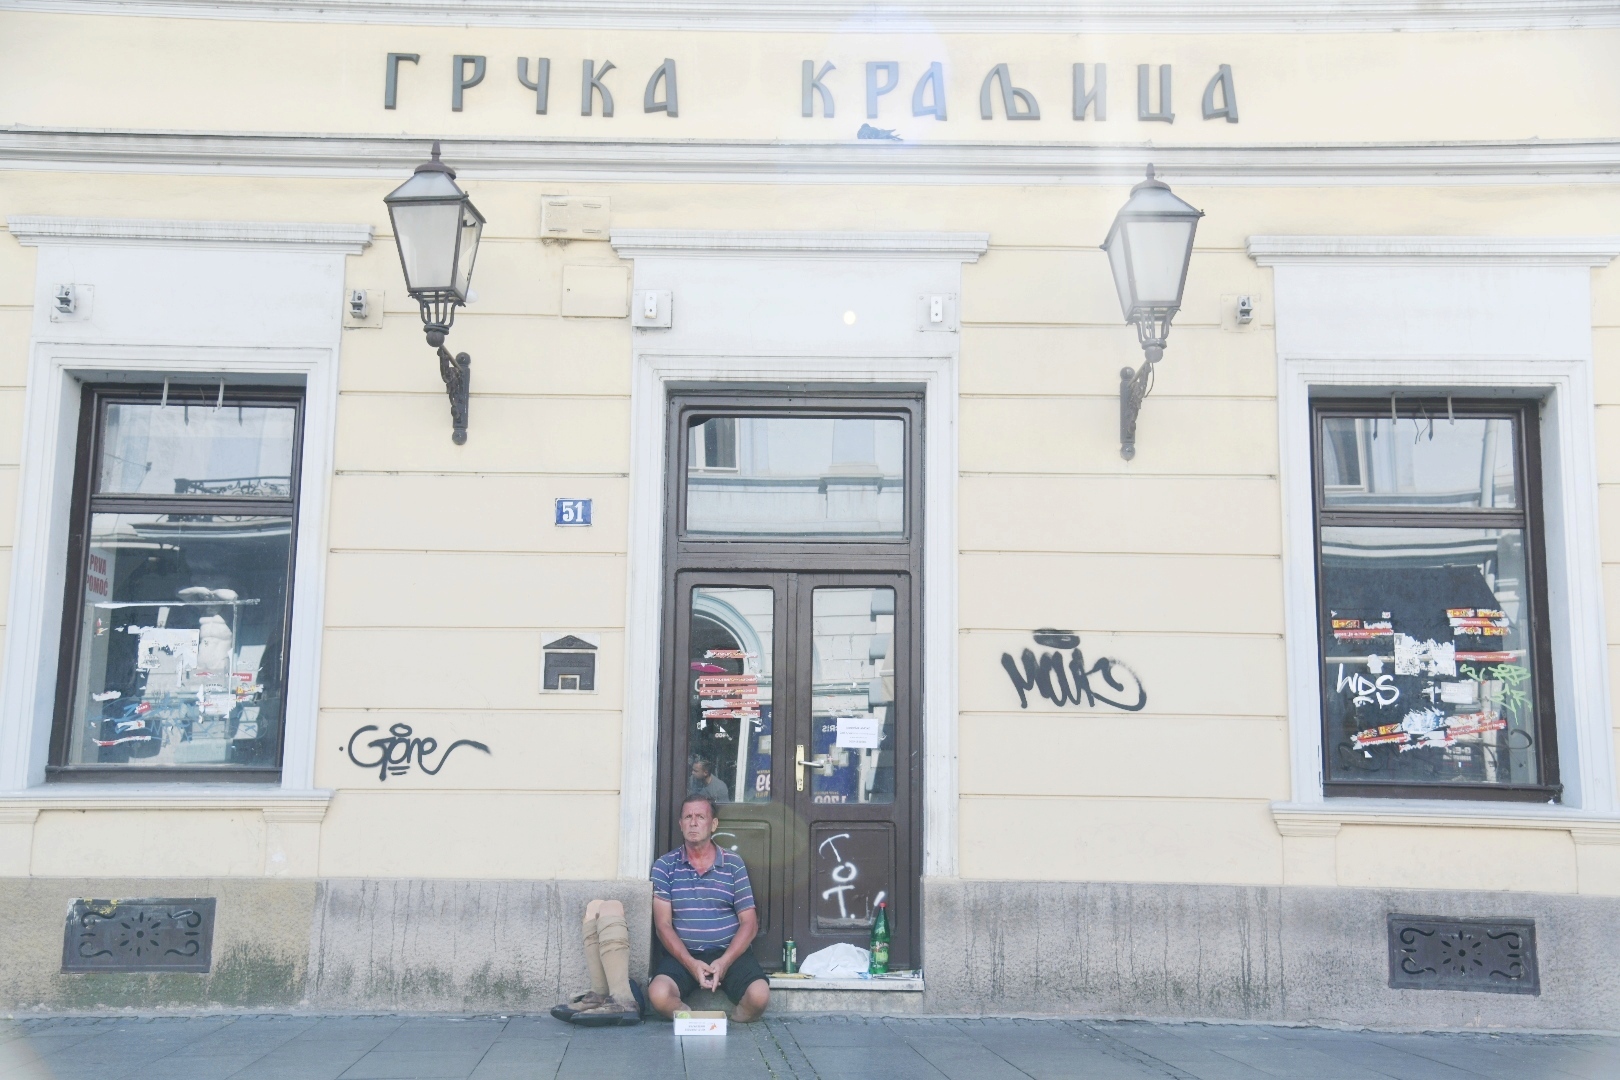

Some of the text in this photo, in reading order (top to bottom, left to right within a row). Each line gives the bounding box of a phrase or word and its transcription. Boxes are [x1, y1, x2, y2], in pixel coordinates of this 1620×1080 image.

[384, 52, 1239, 125] ГРЧКА КРАЉИЦА
[562, 501, 584, 522] 51
[89, 554, 107, 576] PRVA
